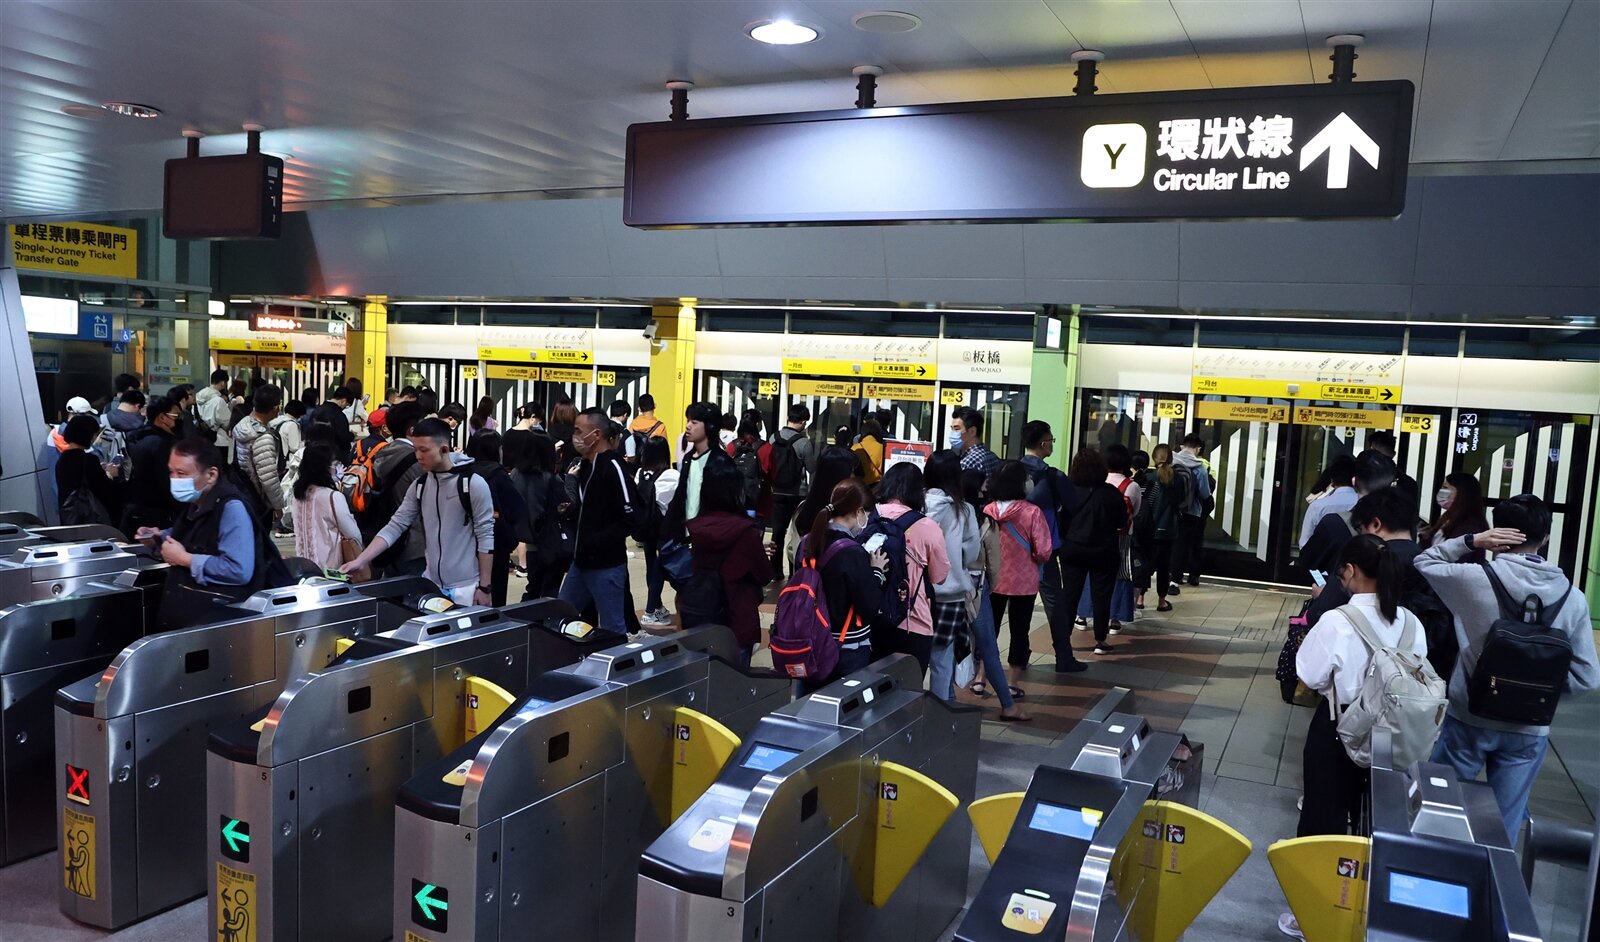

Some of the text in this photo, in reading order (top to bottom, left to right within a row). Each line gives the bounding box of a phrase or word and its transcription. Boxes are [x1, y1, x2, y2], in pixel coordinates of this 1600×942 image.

[1156, 114, 1294, 161] 環狀線
[1103, 143, 1127, 170] Y
[1153, 166, 1290, 191] Circular Line
[15, 223, 127, 251] 單程票轉乘閘門
[15, 241, 116, 260] Single-Journey Ticket
[15, 252, 79, 267] Transfer Gate
[973, 350, 1000, 364] 板橋
[472, 368, 477, 376] 3
[608, 373, 615, 383] 3
[771, 382, 778, 392] 3
[1328, 386, 1370, 395] 新北產業園區
[955, 391, 963, 402] 3
[1174, 403, 1183, 415] 3
[1404, 416, 1431, 430] 車廂 3
[261, 772, 267, 781] 5
[464, 833, 471, 842] 4
[726, 906, 735, 917] 3
